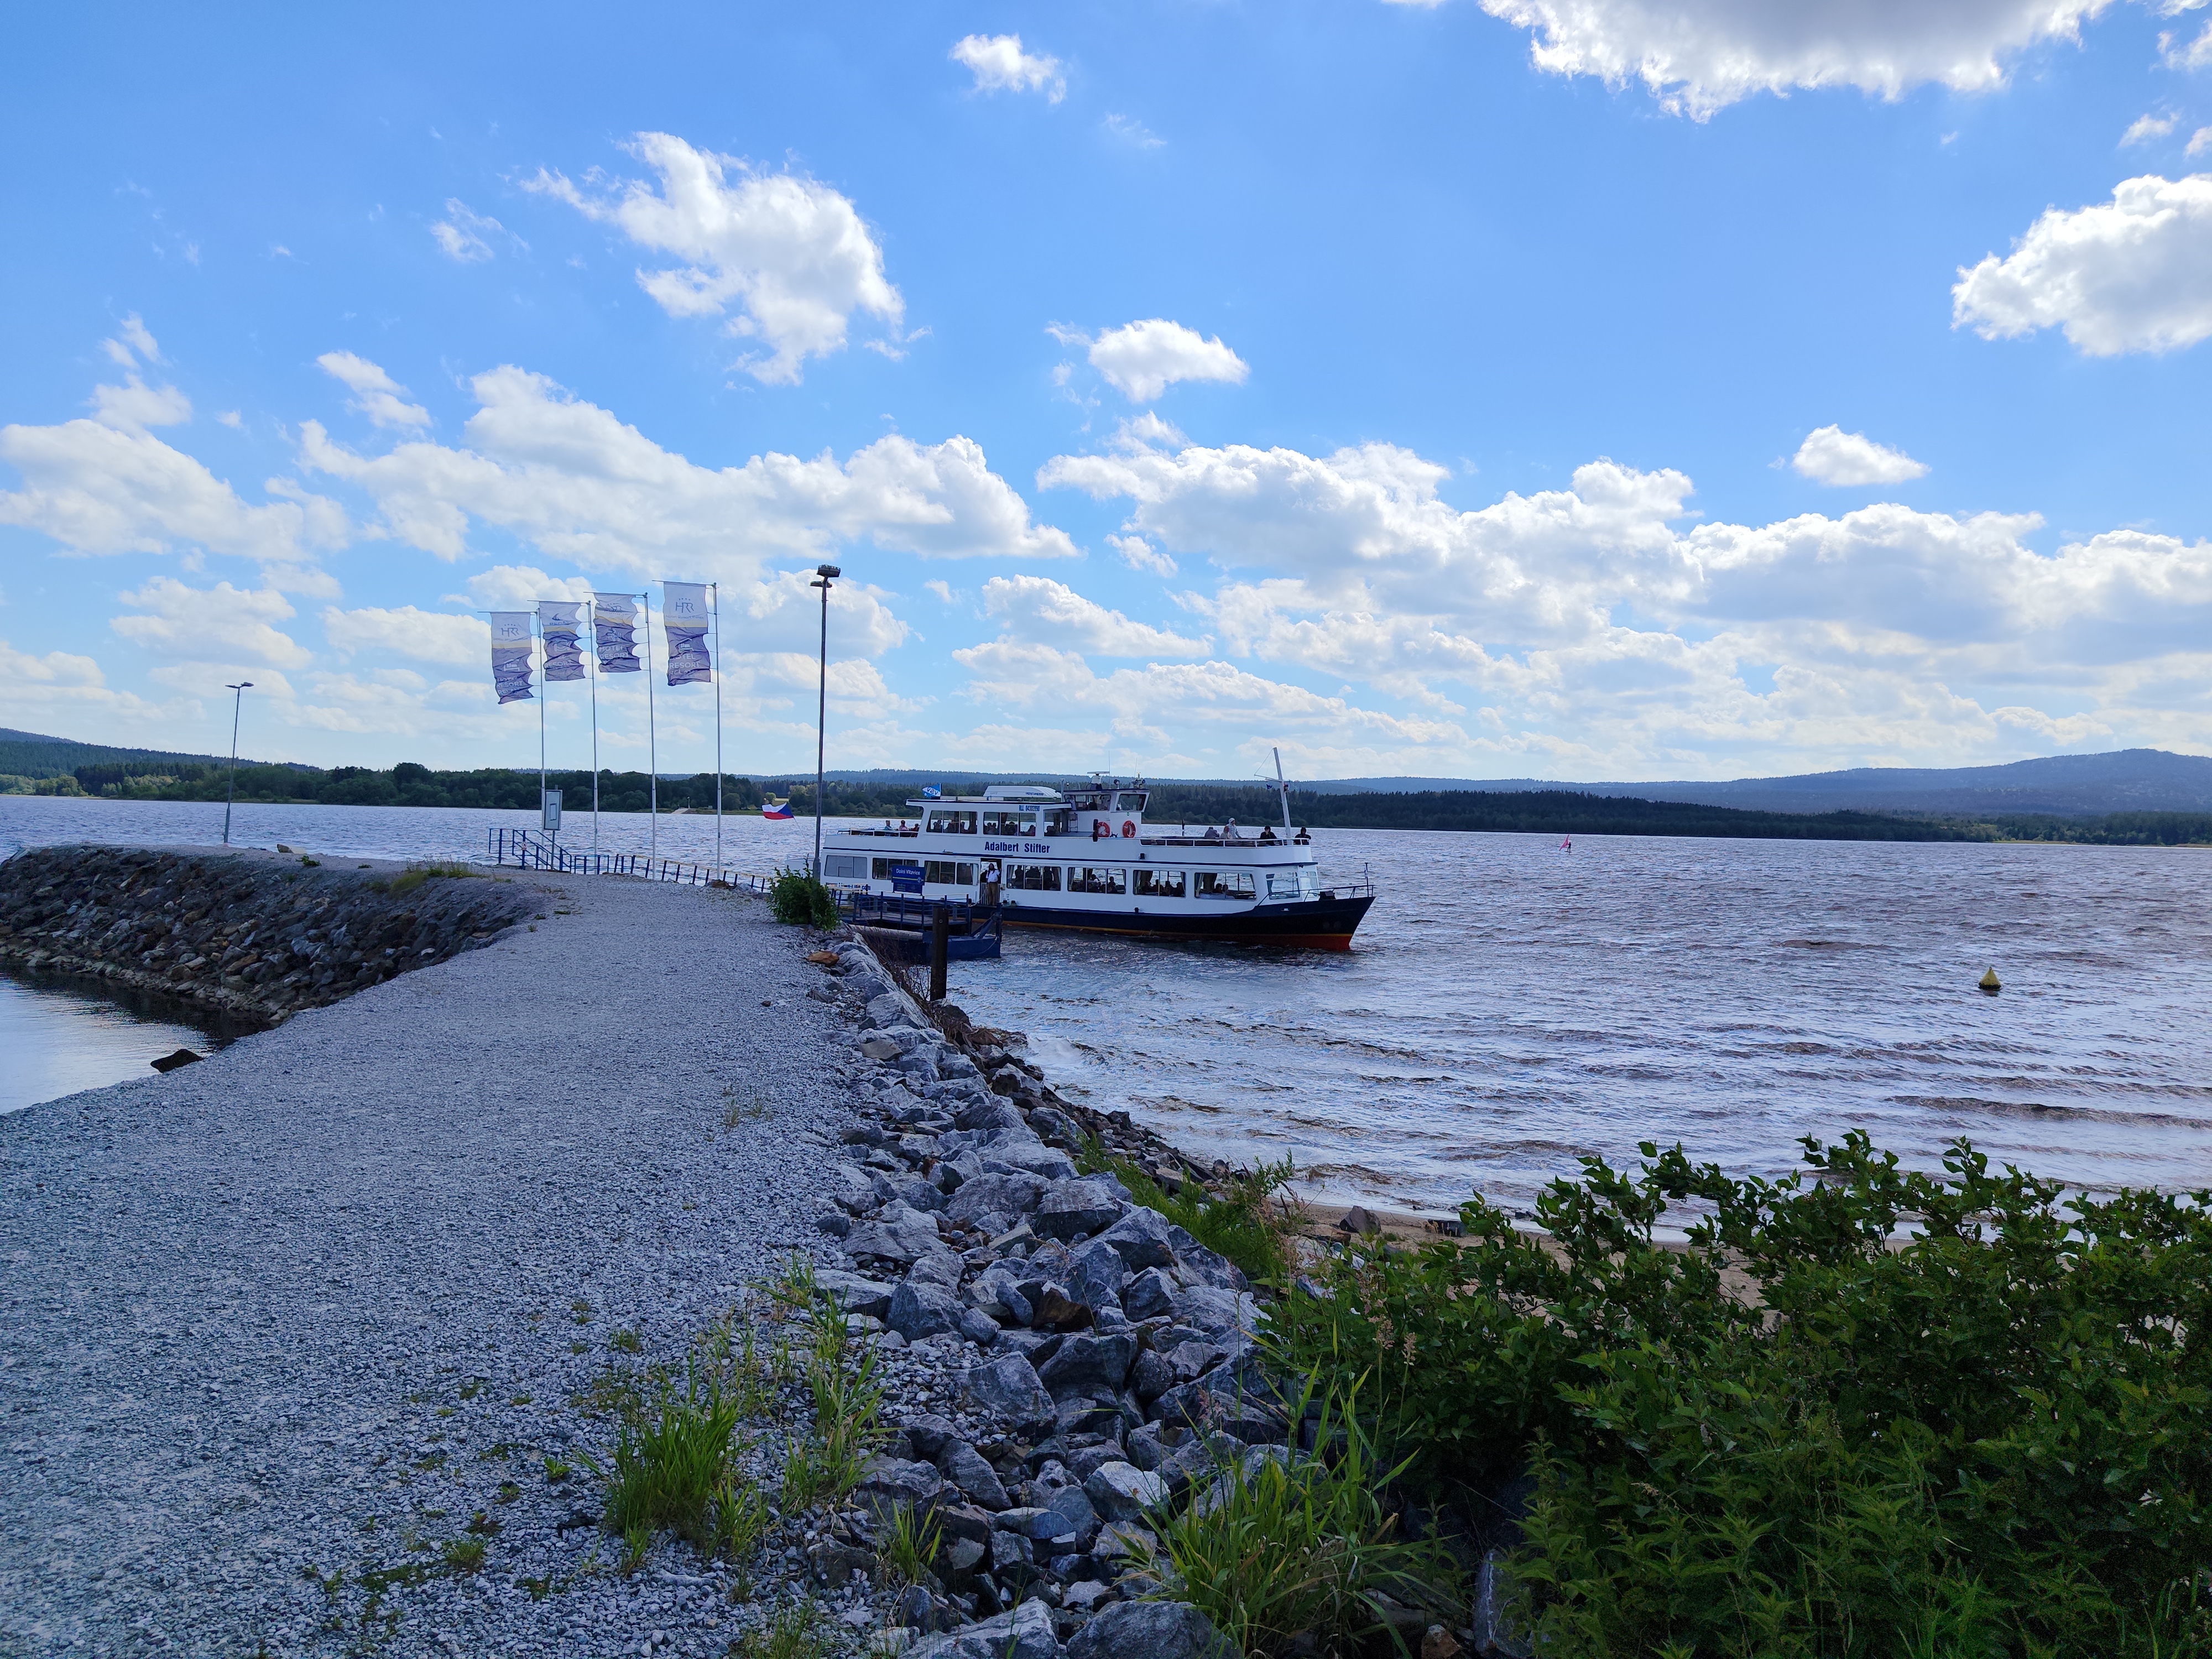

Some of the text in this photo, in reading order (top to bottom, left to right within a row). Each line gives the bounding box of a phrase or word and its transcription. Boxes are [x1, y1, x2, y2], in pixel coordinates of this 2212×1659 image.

[675, 602, 695, 613] HRR
[501, 627, 520, 637] HRR
[984, 841, 1050, 853] Adalbert Stifter
